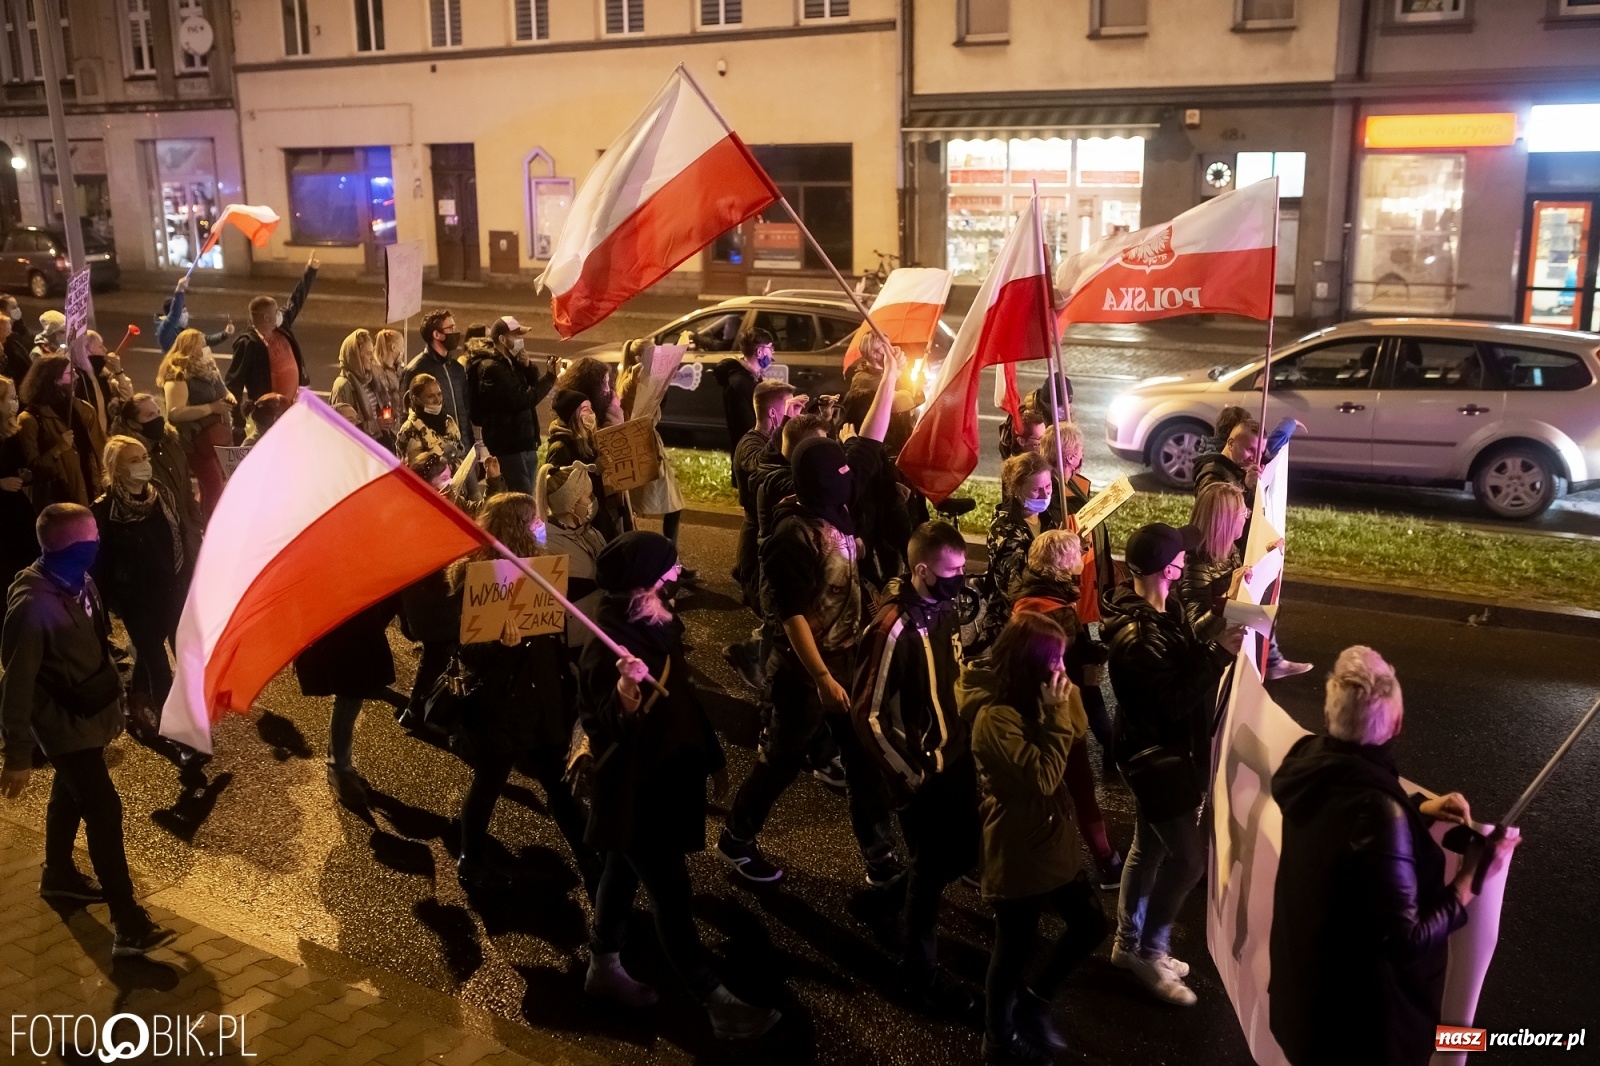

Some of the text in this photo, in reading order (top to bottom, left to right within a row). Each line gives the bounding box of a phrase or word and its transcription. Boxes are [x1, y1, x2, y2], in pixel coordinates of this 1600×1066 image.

[606, 427, 636, 482] KOBIET
[469, 575, 555, 608] WYBÓR NIE
[518, 610, 564, 631] ZAKAZ
